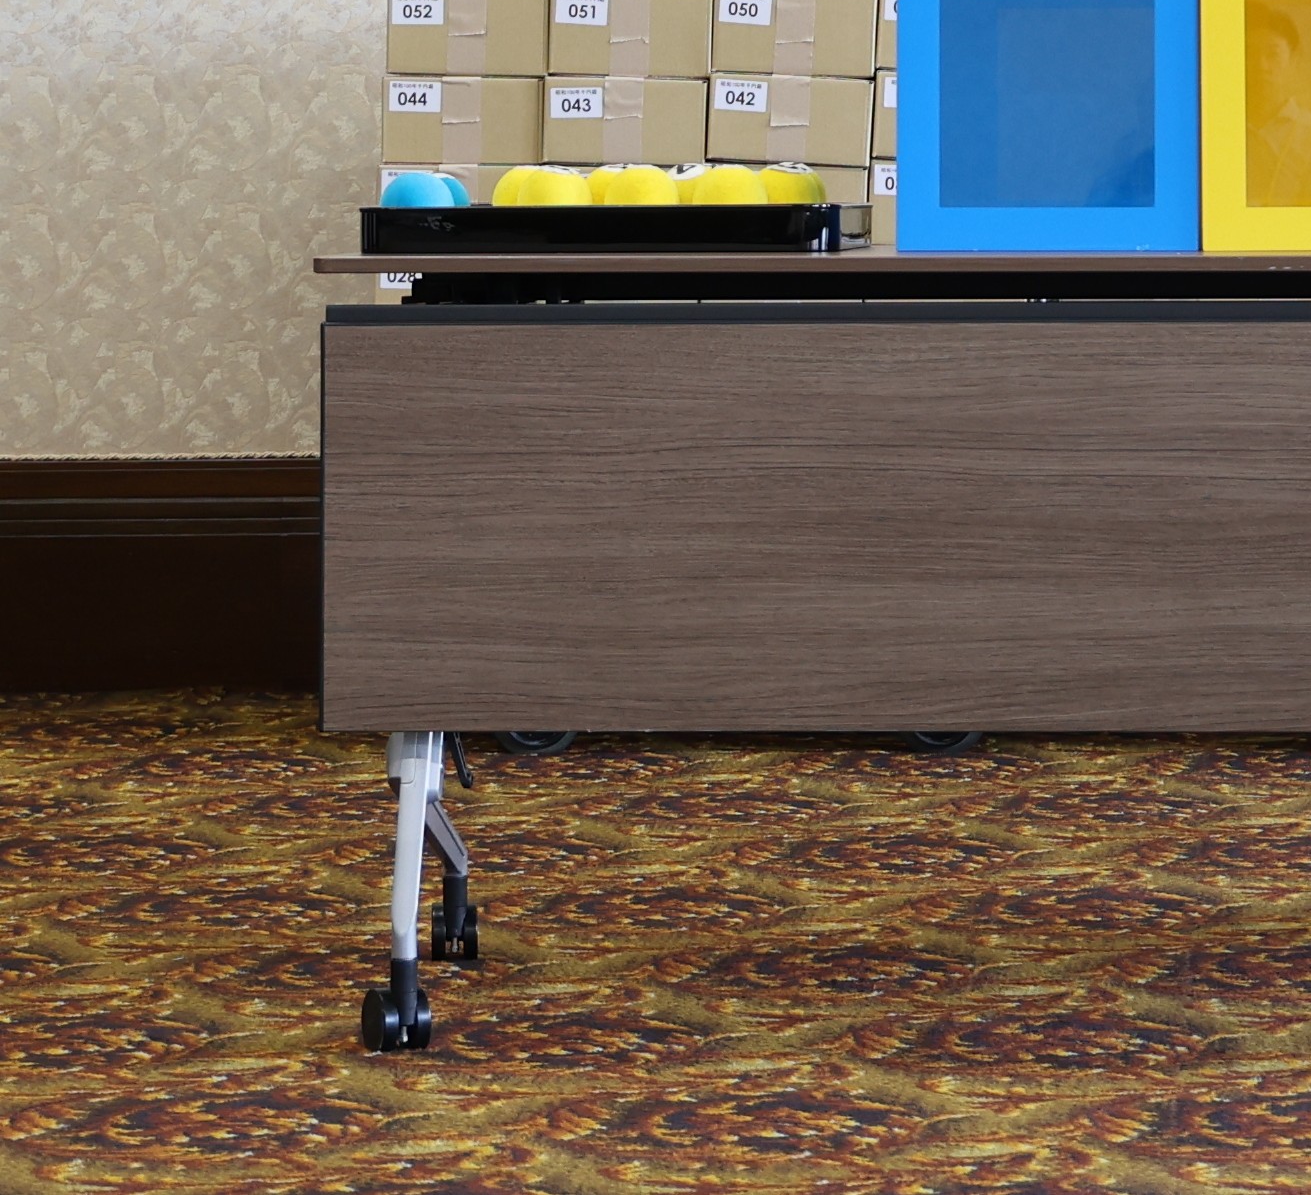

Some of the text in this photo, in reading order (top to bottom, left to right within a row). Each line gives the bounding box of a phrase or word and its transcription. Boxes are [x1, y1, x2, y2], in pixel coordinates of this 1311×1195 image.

[403, 4, 433, 19] 052
[568, 4, 596, 19] 051
[728, 1, 759, 17] 050
[397, 91, 428, 106] 044
[561, 98, 592, 113] 043
[725, 90, 756, 106] 042
